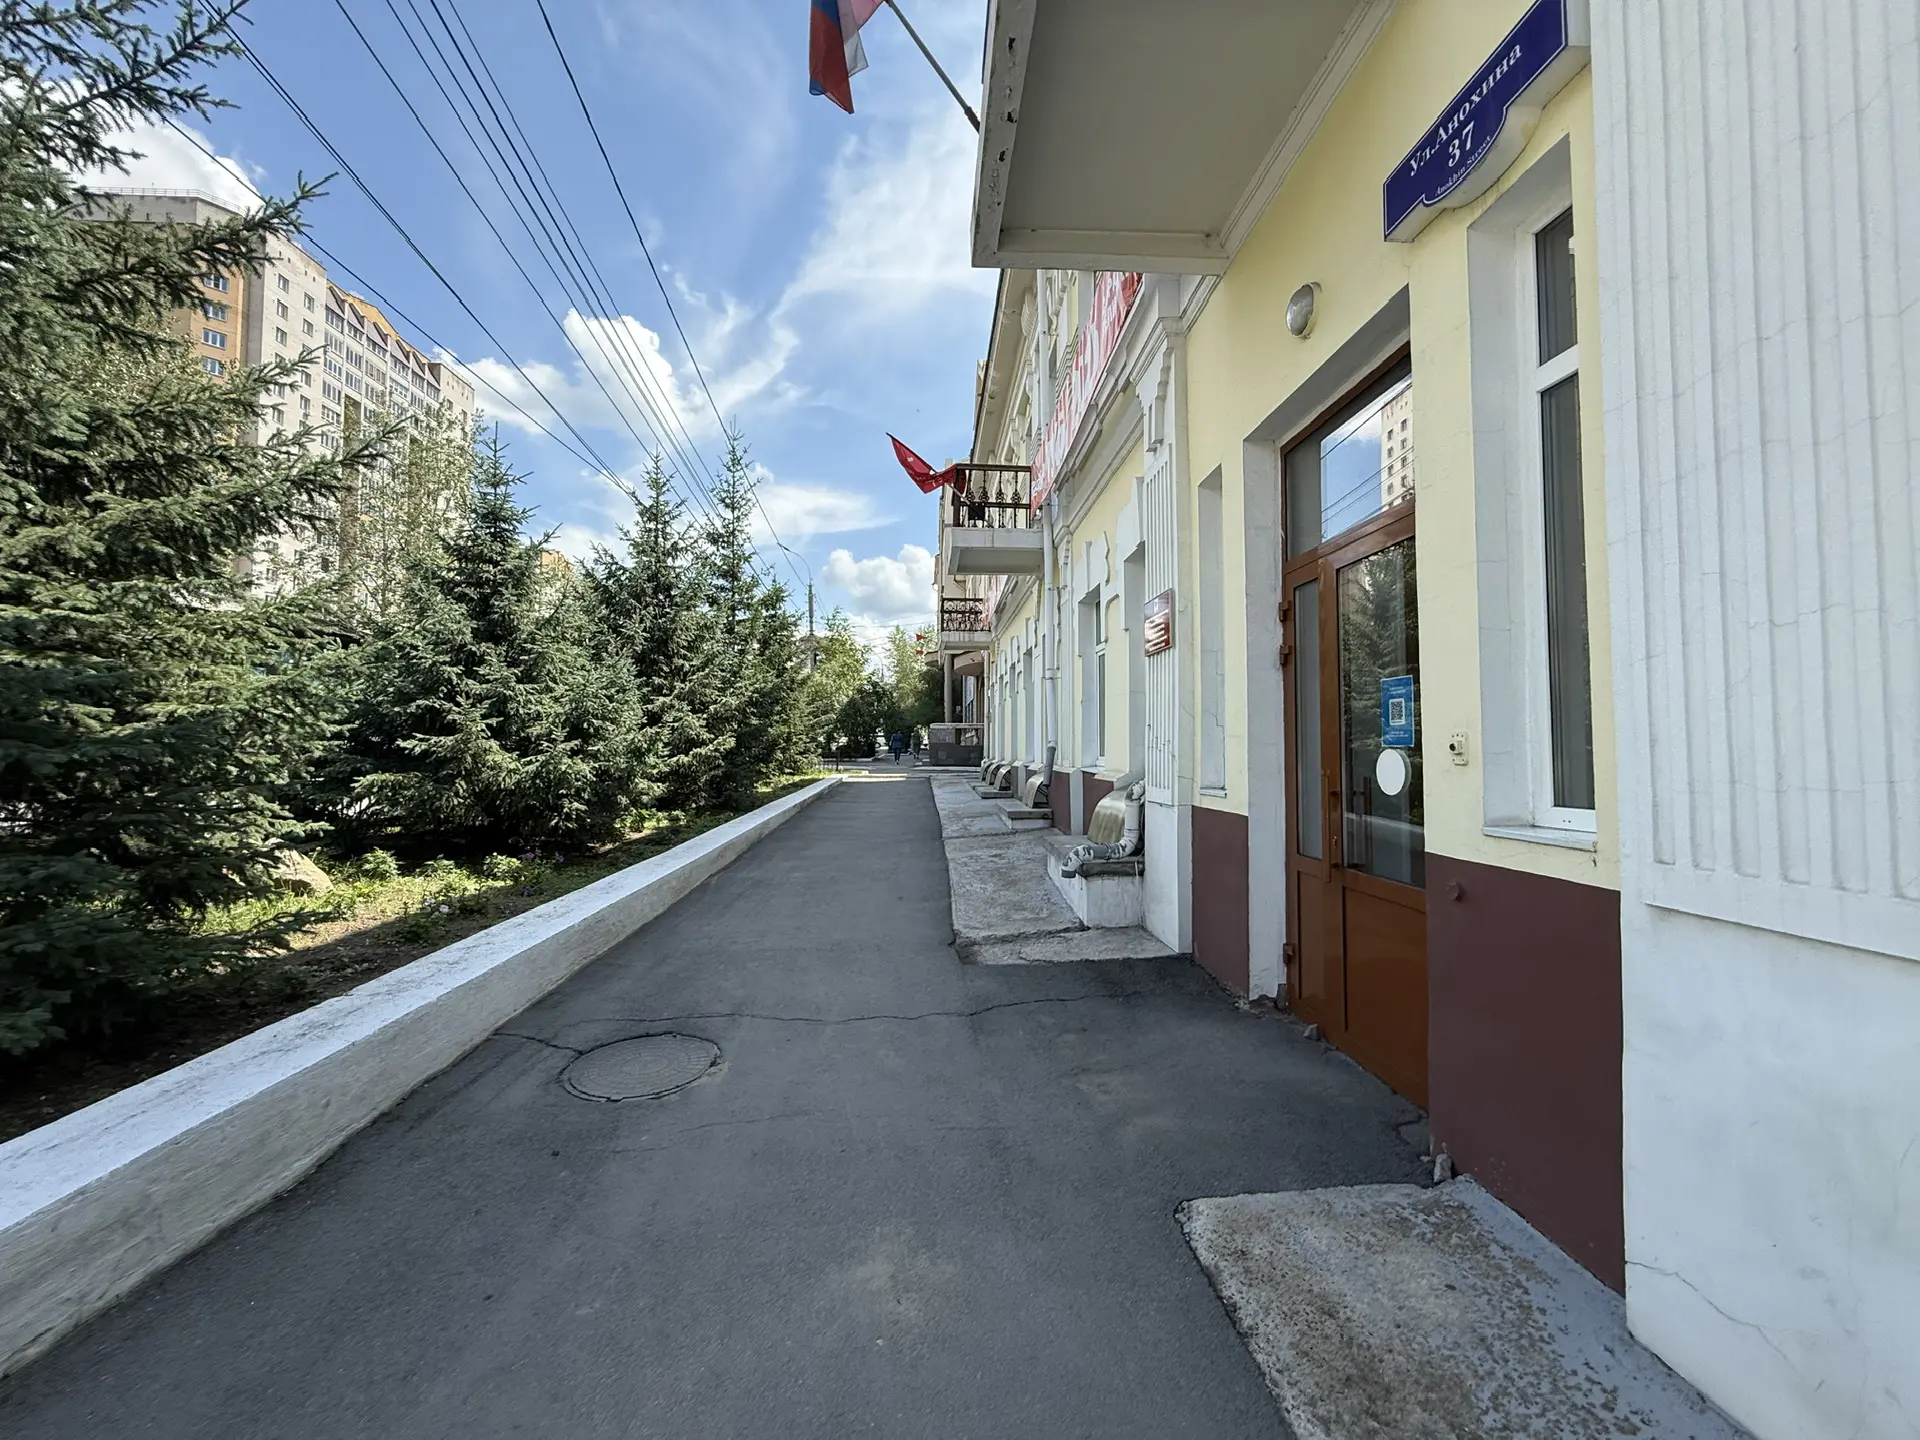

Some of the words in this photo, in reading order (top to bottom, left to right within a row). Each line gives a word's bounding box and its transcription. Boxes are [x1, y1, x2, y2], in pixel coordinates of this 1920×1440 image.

[1434, 167, 1466, 196] Anokhin
[1466, 135, 1492, 167] Street
[1447, 120, 1475, 167] 37
